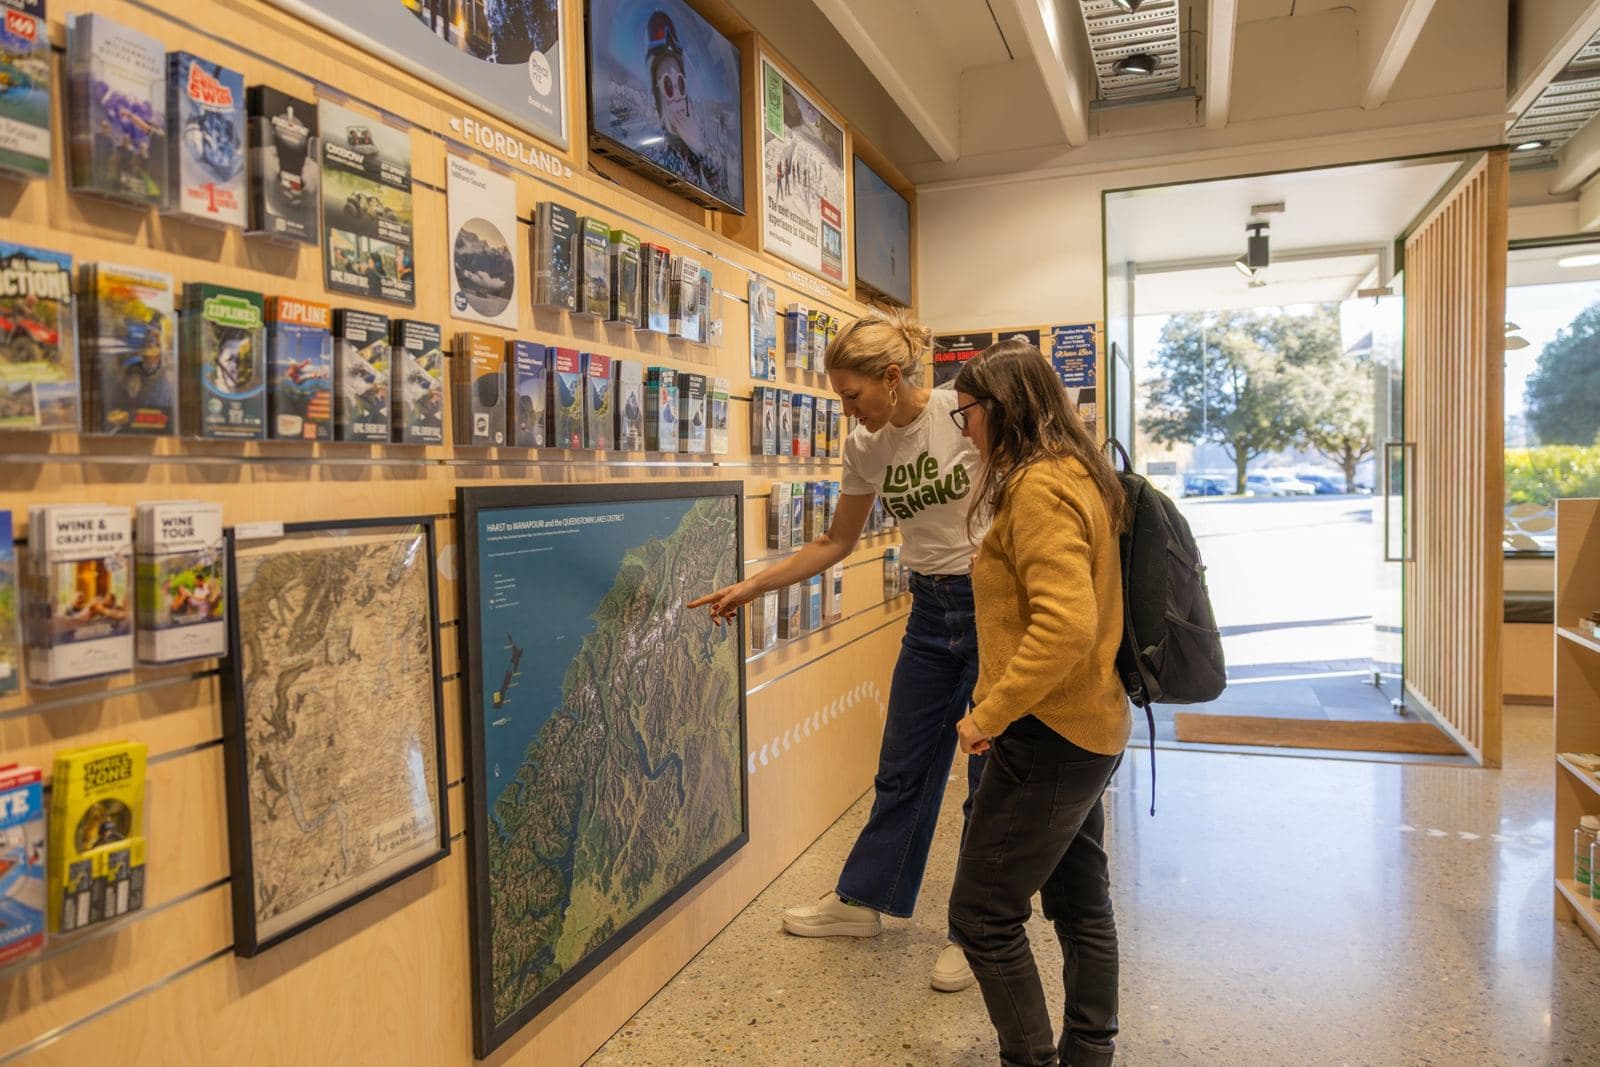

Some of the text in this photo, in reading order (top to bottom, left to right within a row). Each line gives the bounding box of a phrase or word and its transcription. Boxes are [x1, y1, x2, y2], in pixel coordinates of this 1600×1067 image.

[463, 117, 562, 178] FIORDLAND
[281, 301, 327, 325] ZIPLINE
[56, 520, 106, 532] WINE &
[161, 516, 193, 527] WINE
[486, 514, 624, 532] HAAST to MANAPOURI and the QUEENSTOWN LAKES DISTRICT
[56, 532, 124, 546] CRAFT BEER
[161, 528, 194, 539] TOUR
[84, 766, 131, 791] ZONE
